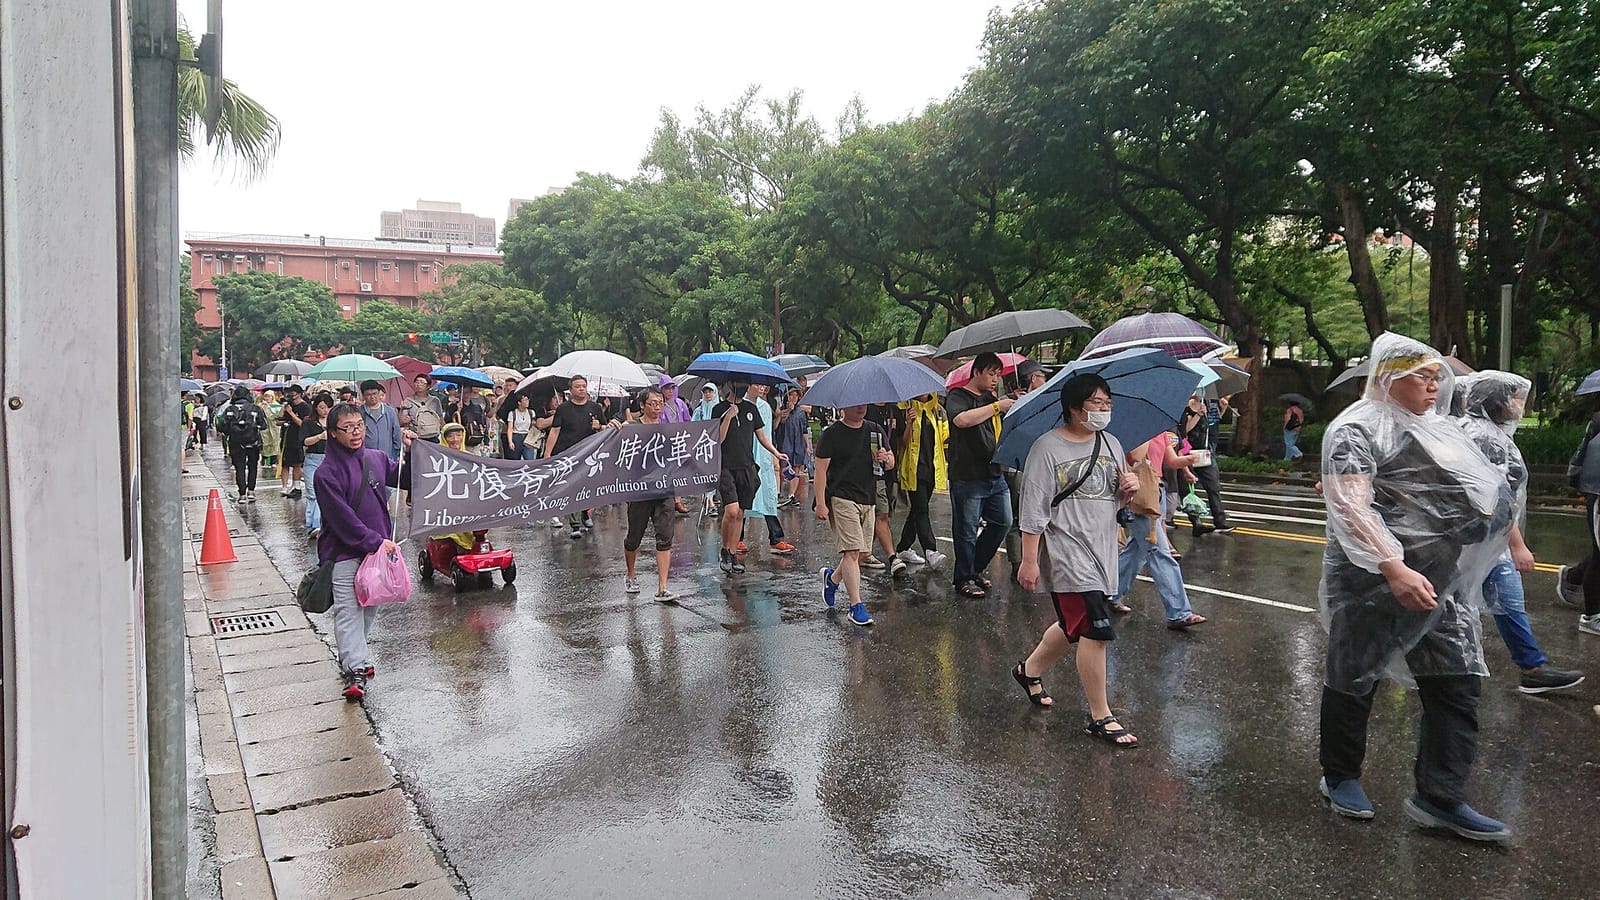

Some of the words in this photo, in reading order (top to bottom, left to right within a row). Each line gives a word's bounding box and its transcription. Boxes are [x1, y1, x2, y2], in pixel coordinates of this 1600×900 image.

[421, 453, 579, 501] 光復香港
[615, 429, 717, 470] 時代革命
[423, 508, 487, 527] Libera
[537, 495, 569, 511] Kong
[575, 486, 591, 501] the
[596, 478, 648, 497] revolution
[655, 474, 668, 489] of
[673, 476, 688, 488] our
[693, 473, 719, 485] times
